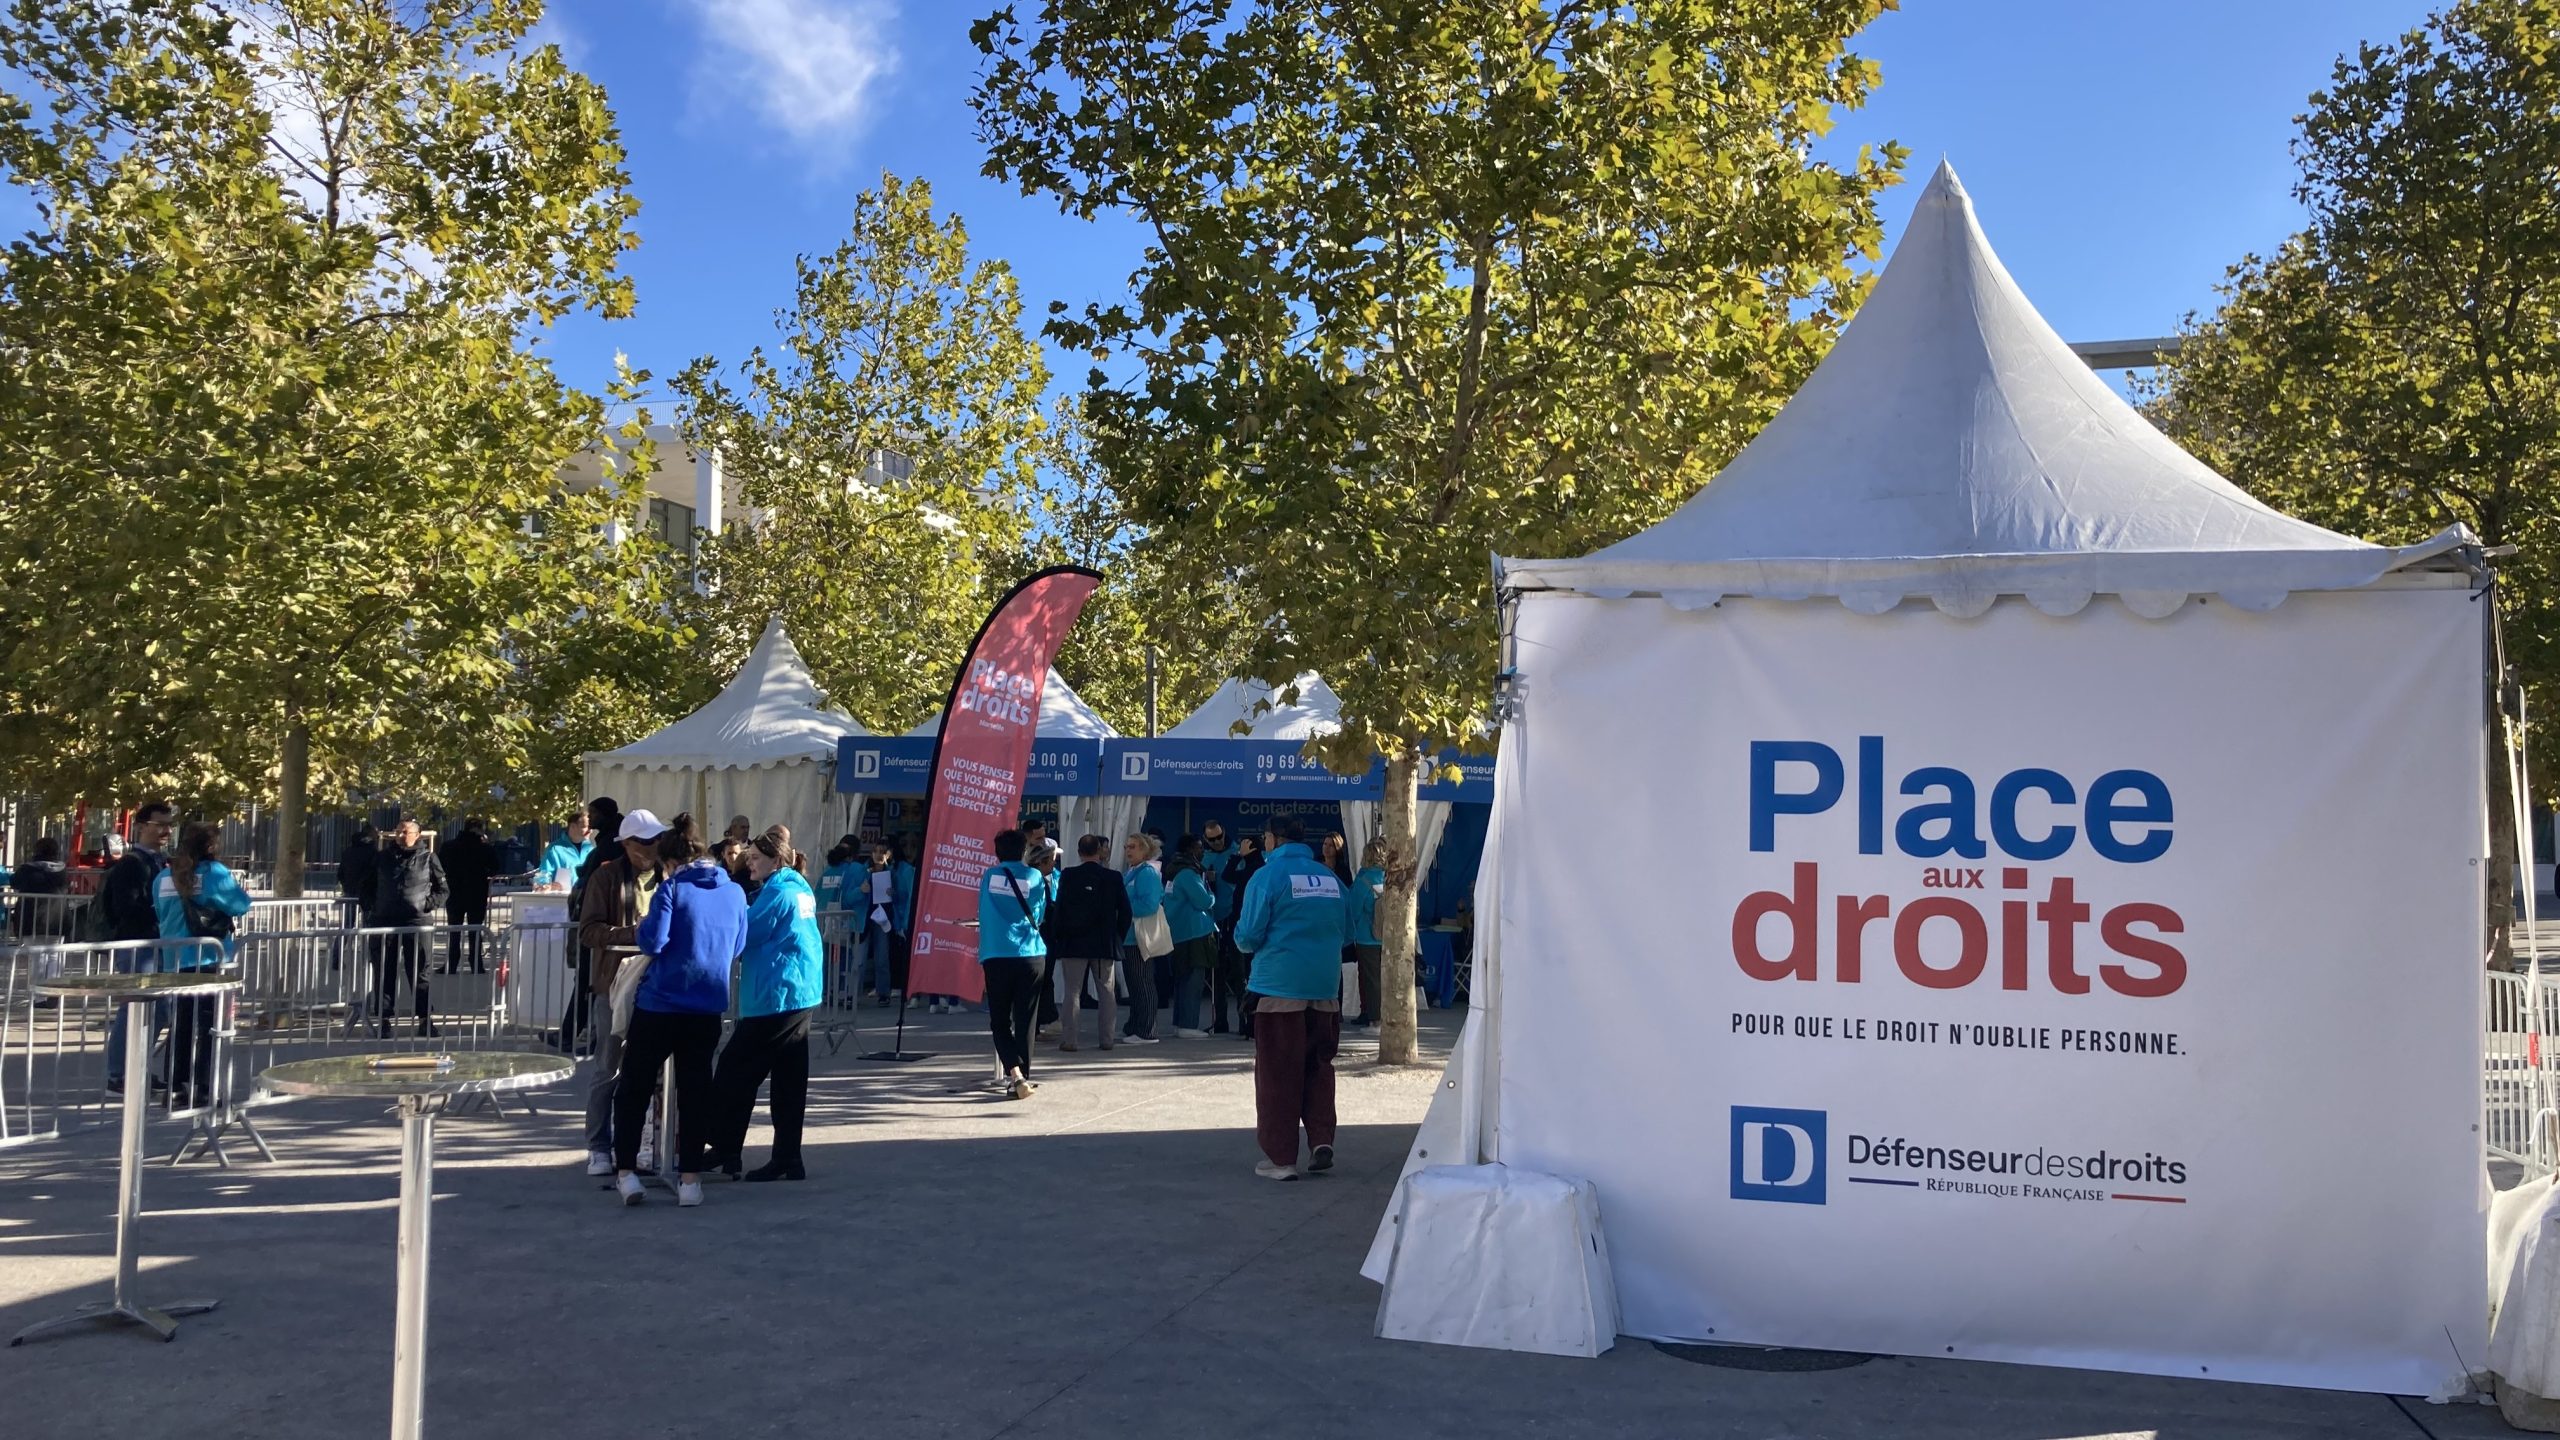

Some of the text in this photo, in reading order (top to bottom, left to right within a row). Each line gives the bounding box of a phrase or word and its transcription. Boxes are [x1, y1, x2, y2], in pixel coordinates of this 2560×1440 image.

[970, 658, 1035, 700] Place
[960, 684, 1032, 726] droits
[952, 757, 1015, 781] VOUS PENSEZ
[1029, 752, 1078, 767] 9 00 00
[1153, 758, 1244, 770] Défenseurdesdroits
[1257, 754, 1274, 769] 09
[1279, 755, 1295, 769] 69
[943, 768, 1017, 795] QUE VOS DROITS
[948, 782, 1009, 806] NE SONT PAS
[1749, 736, 2174, 864] Place
[947, 795, 996, 816] RESPECTÉS
[995, 807, 1002, 817] ?
[1025, 799, 1058, 816] juris
[1238, 800, 1340, 816] Contactez-no
[953, 833, 984, 850] VENEZ
[933, 855, 988, 875] NOS JURIST
[930, 868, 983, 888] RATUITEM
[1923, 867, 1984, 889] aux
[1732, 862, 2187, 997] droits
[1732, 1013, 1784, 1036] POUR
[1795, 1016, 1833, 1038] QUE
[1843, 1018, 1866, 1039] LE
[1877, 1020, 1939, 1043] DROIT
[2061, 1029, 2187, 1056] PERSONNE.
[1848, 1135, 2187, 1184] Défenseurdesdroits
